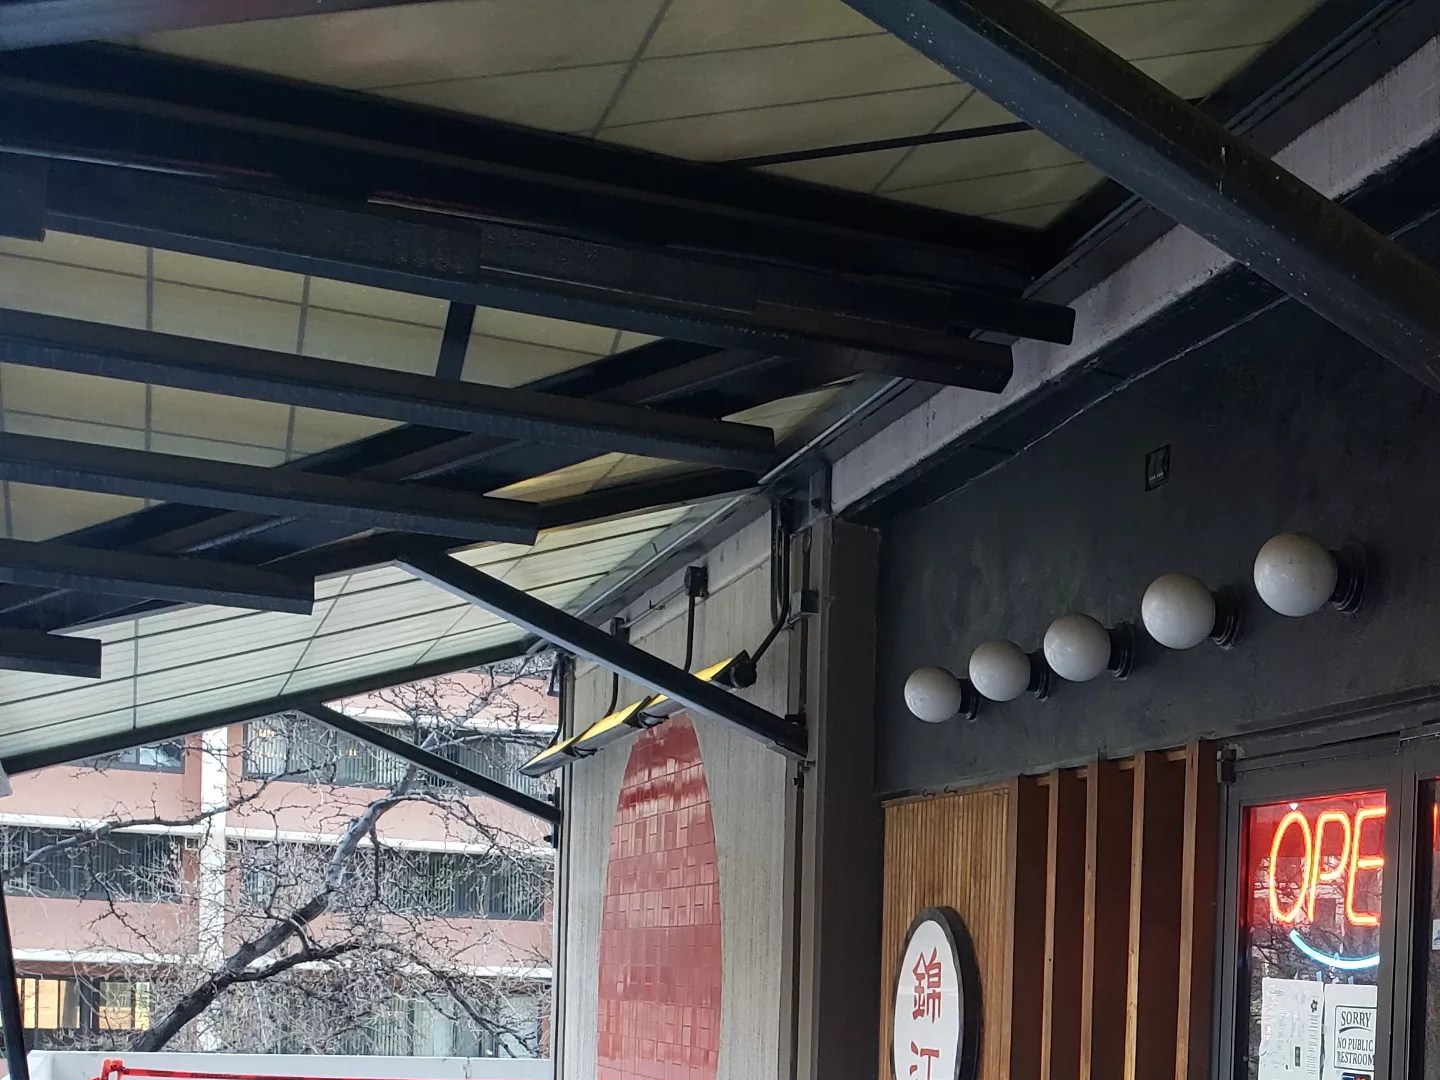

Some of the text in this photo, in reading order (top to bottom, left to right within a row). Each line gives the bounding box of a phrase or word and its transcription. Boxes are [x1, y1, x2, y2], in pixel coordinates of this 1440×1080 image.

[1268, 808, 1387, 925] OPE
[1340, 1010, 1372, 1028] SORRY
[1337, 1036, 1374, 1052] NO PUBLIC
